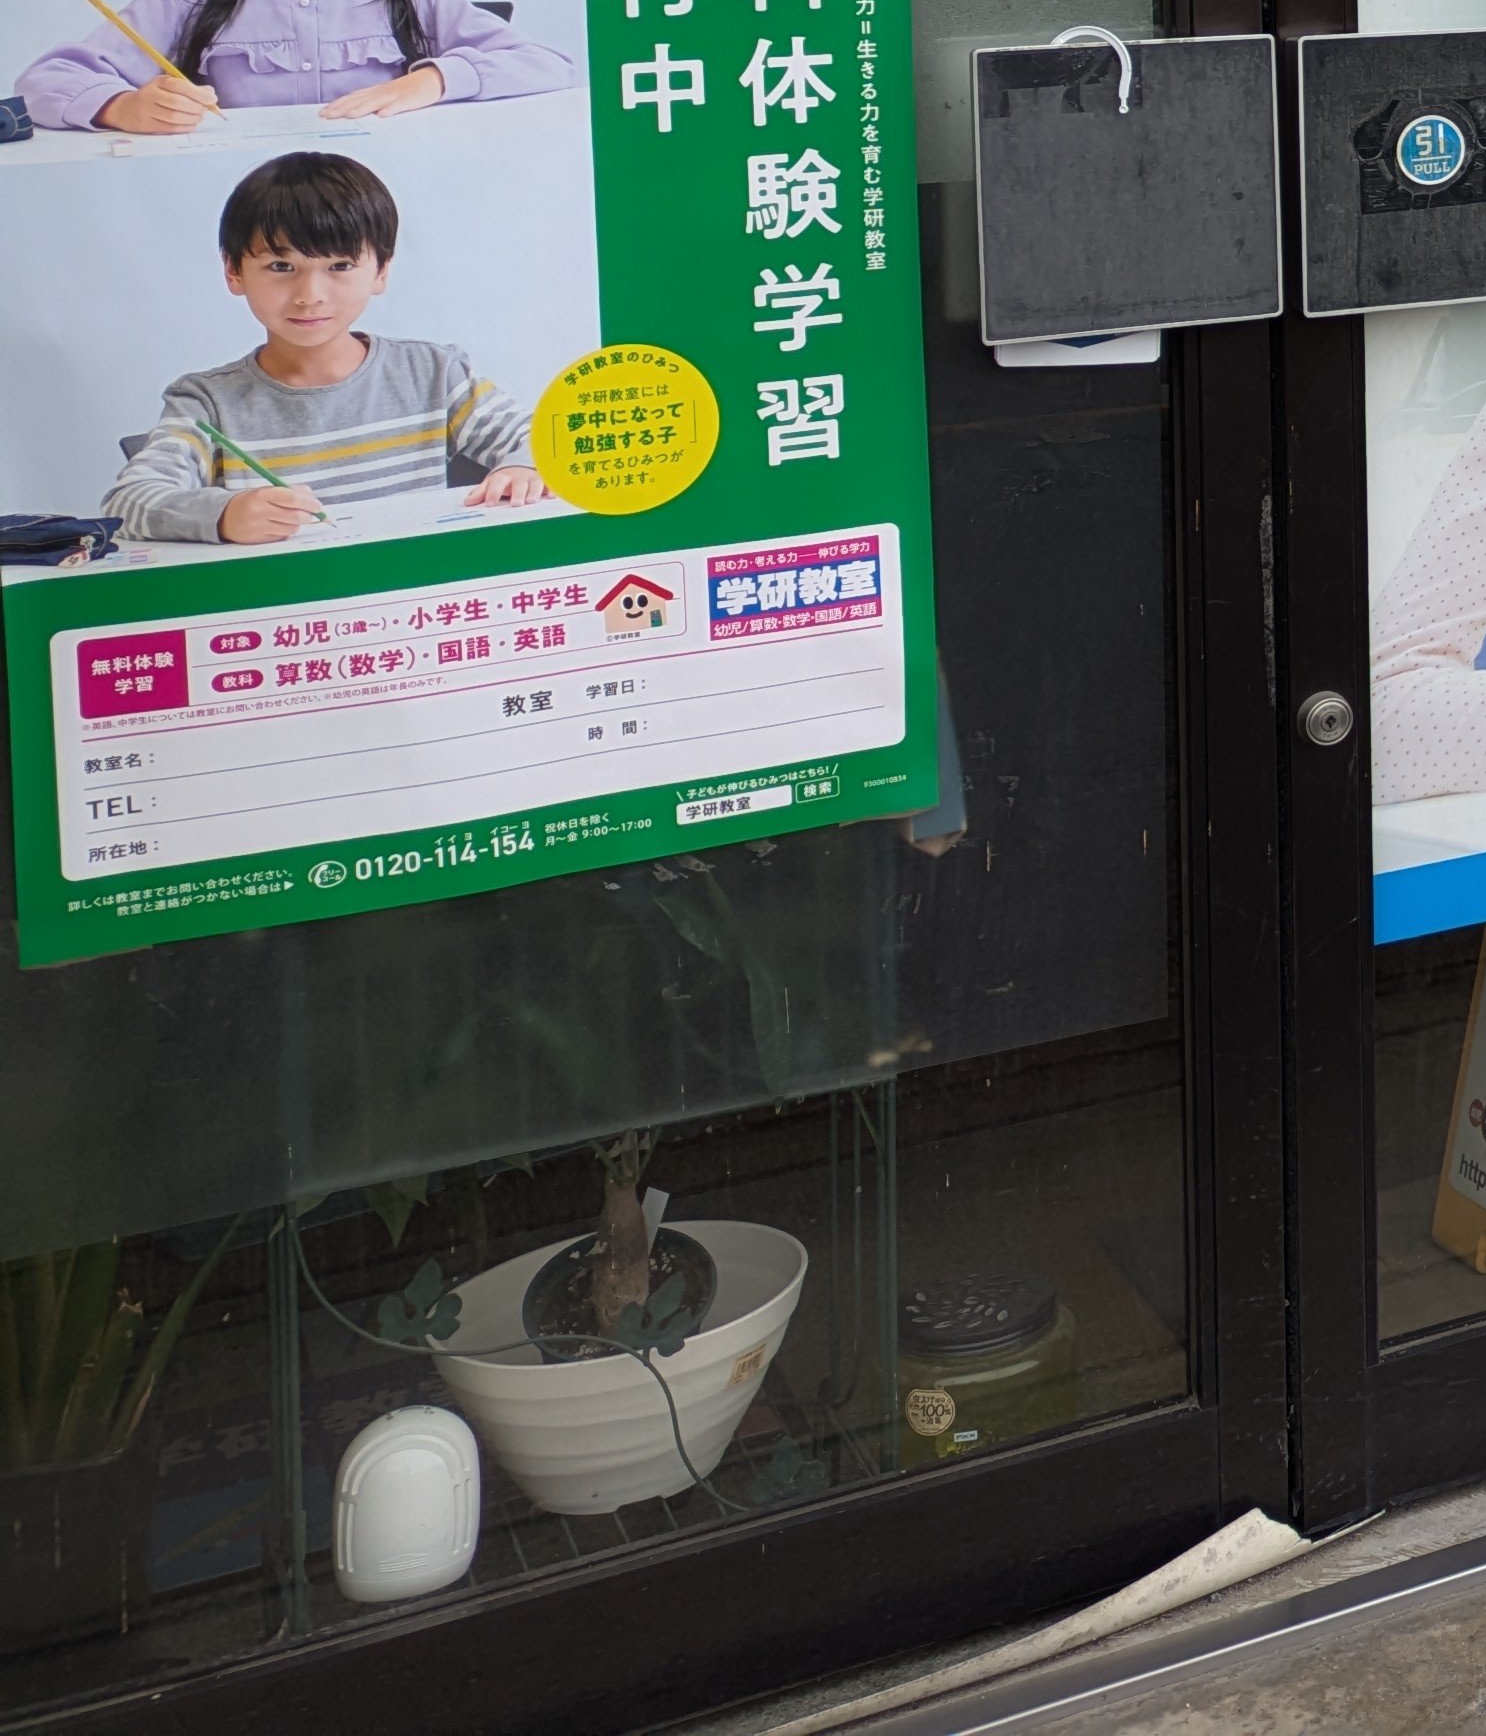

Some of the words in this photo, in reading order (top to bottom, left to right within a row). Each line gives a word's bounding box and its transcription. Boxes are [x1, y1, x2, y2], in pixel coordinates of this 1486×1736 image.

[1413, 162, 1451, 176] PULL
[564, 351, 680, 387] 学研教室のひみつ
[577, 384, 670, 406] 学研教室には
[566, 402, 685, 432] 夢中になって
[574, 426, 677, 455] 勉強する子
[568, 449, 685, 475] を育てるひみつが
[595, 471, 656, 490] あります。
[716, 560, 877, 616] 学研教室
[220, 636, 251, 651] 対象
[91, 652, 175, 677] 無料体験
[114, 676, 155, 695] 学習
[222, 674, 253, 689] 教科
[502, 690, 553, 718] 教室
[803, 781, 832, 797] 検索
[685, 796, 751, 820] 学研教室
[355, 830, 535, 881] 0120-114-154
